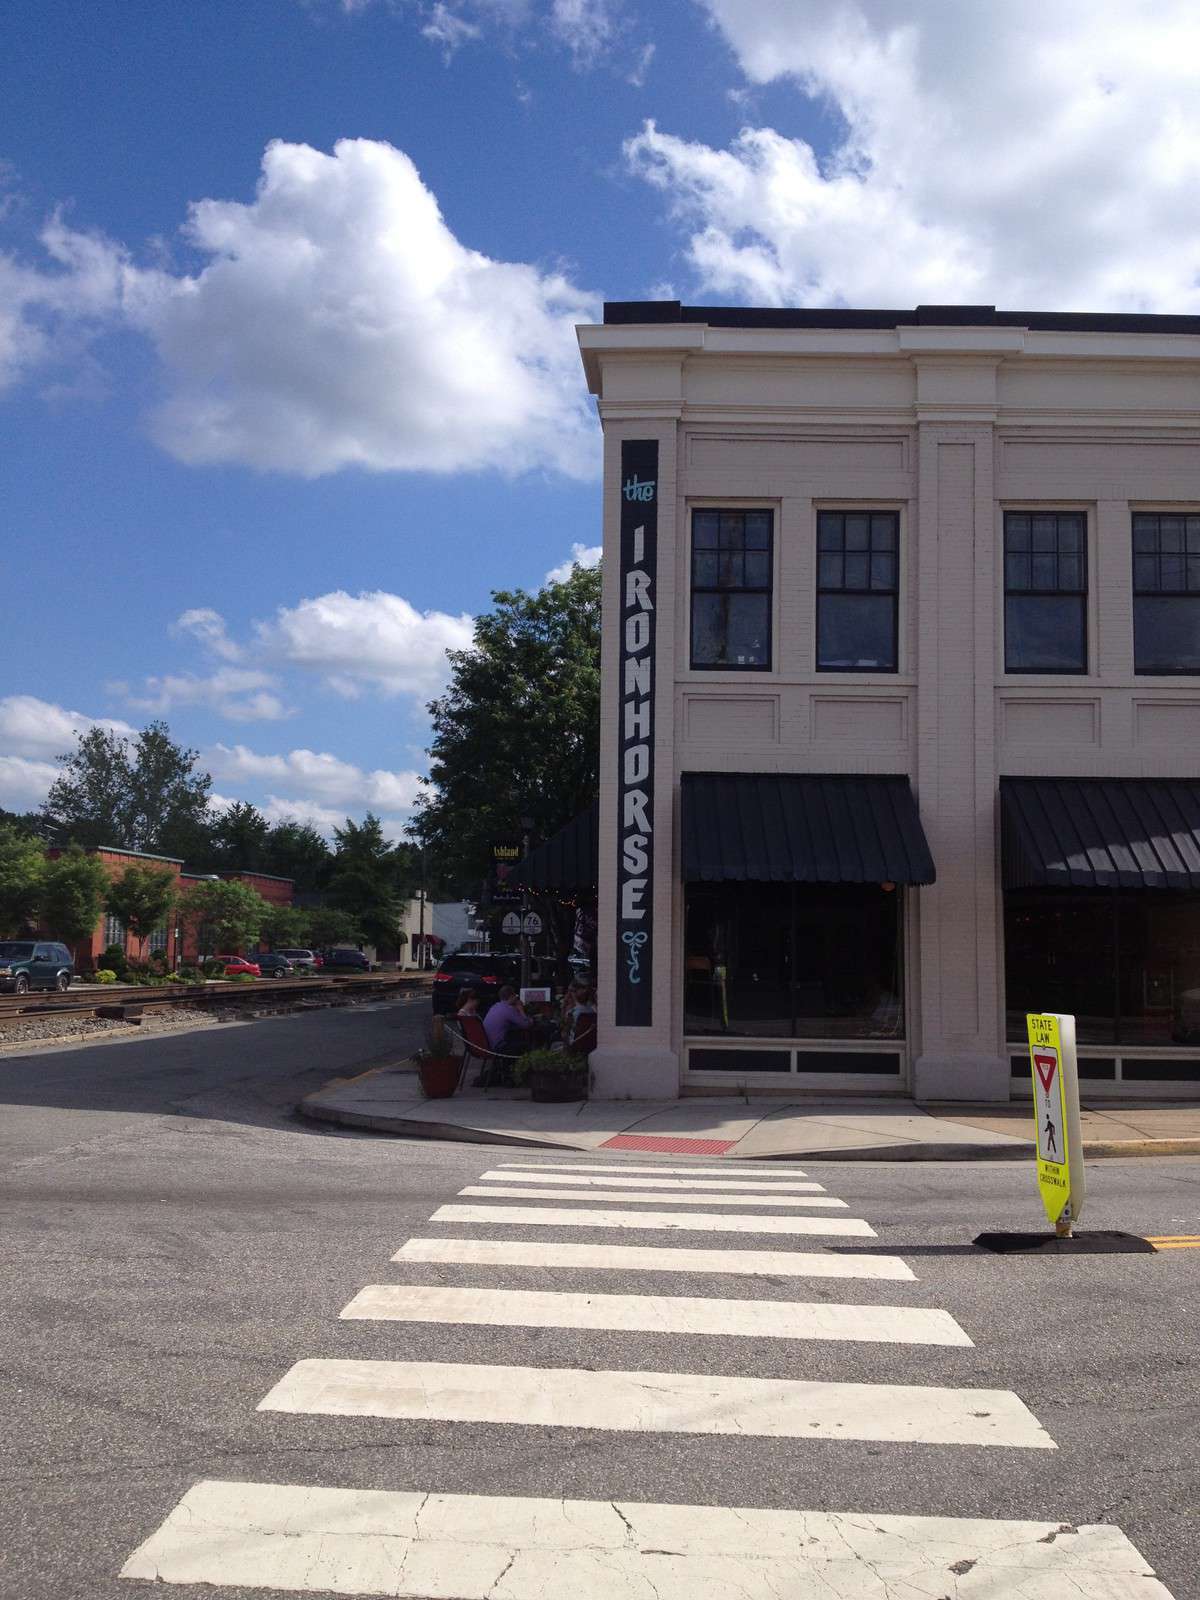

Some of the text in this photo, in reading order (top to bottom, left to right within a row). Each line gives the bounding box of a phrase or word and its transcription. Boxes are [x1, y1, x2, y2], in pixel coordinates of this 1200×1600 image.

[623, 473, 655, 502] the
[527, 916, 539, 925] 76
[1031, 1018, 1053, 1031] STATE
[1035, 1032, 1050, 1044] LAW
[1039, 1172, 1066, 1188] CROSSWALK
